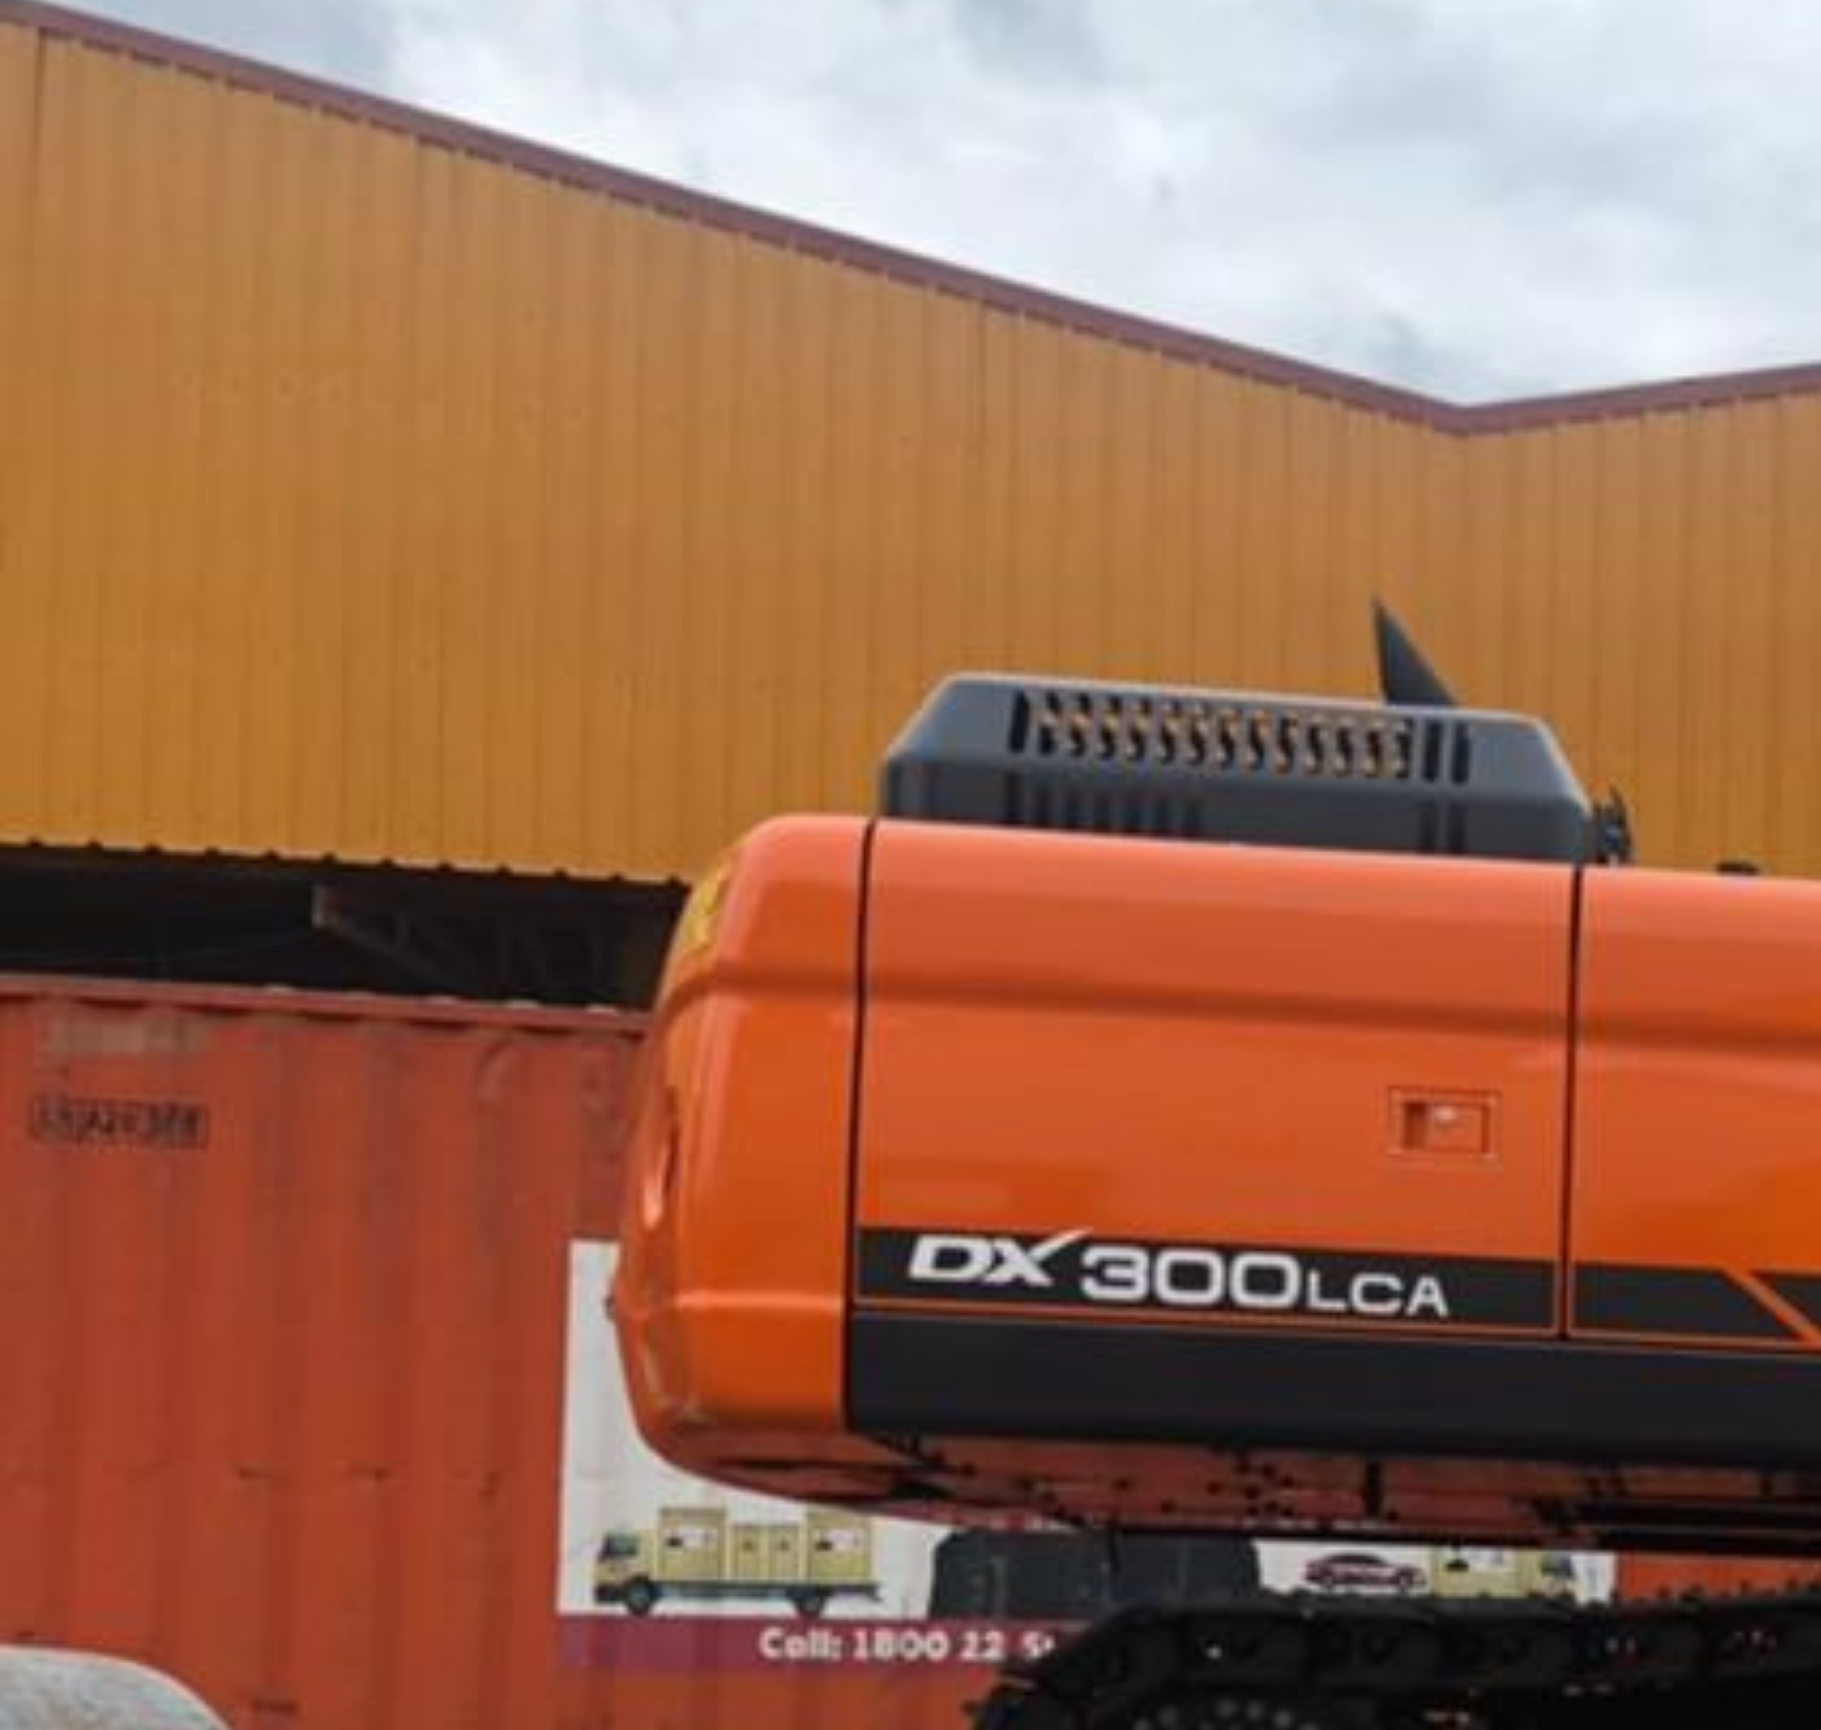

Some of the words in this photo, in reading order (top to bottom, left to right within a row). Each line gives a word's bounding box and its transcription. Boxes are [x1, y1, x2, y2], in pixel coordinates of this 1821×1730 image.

[908, 1227, 1094, 1286] DX
[1080, 1246, 1449, 1317] 300LCA
[851, 1628, 950, 1662] 1800
